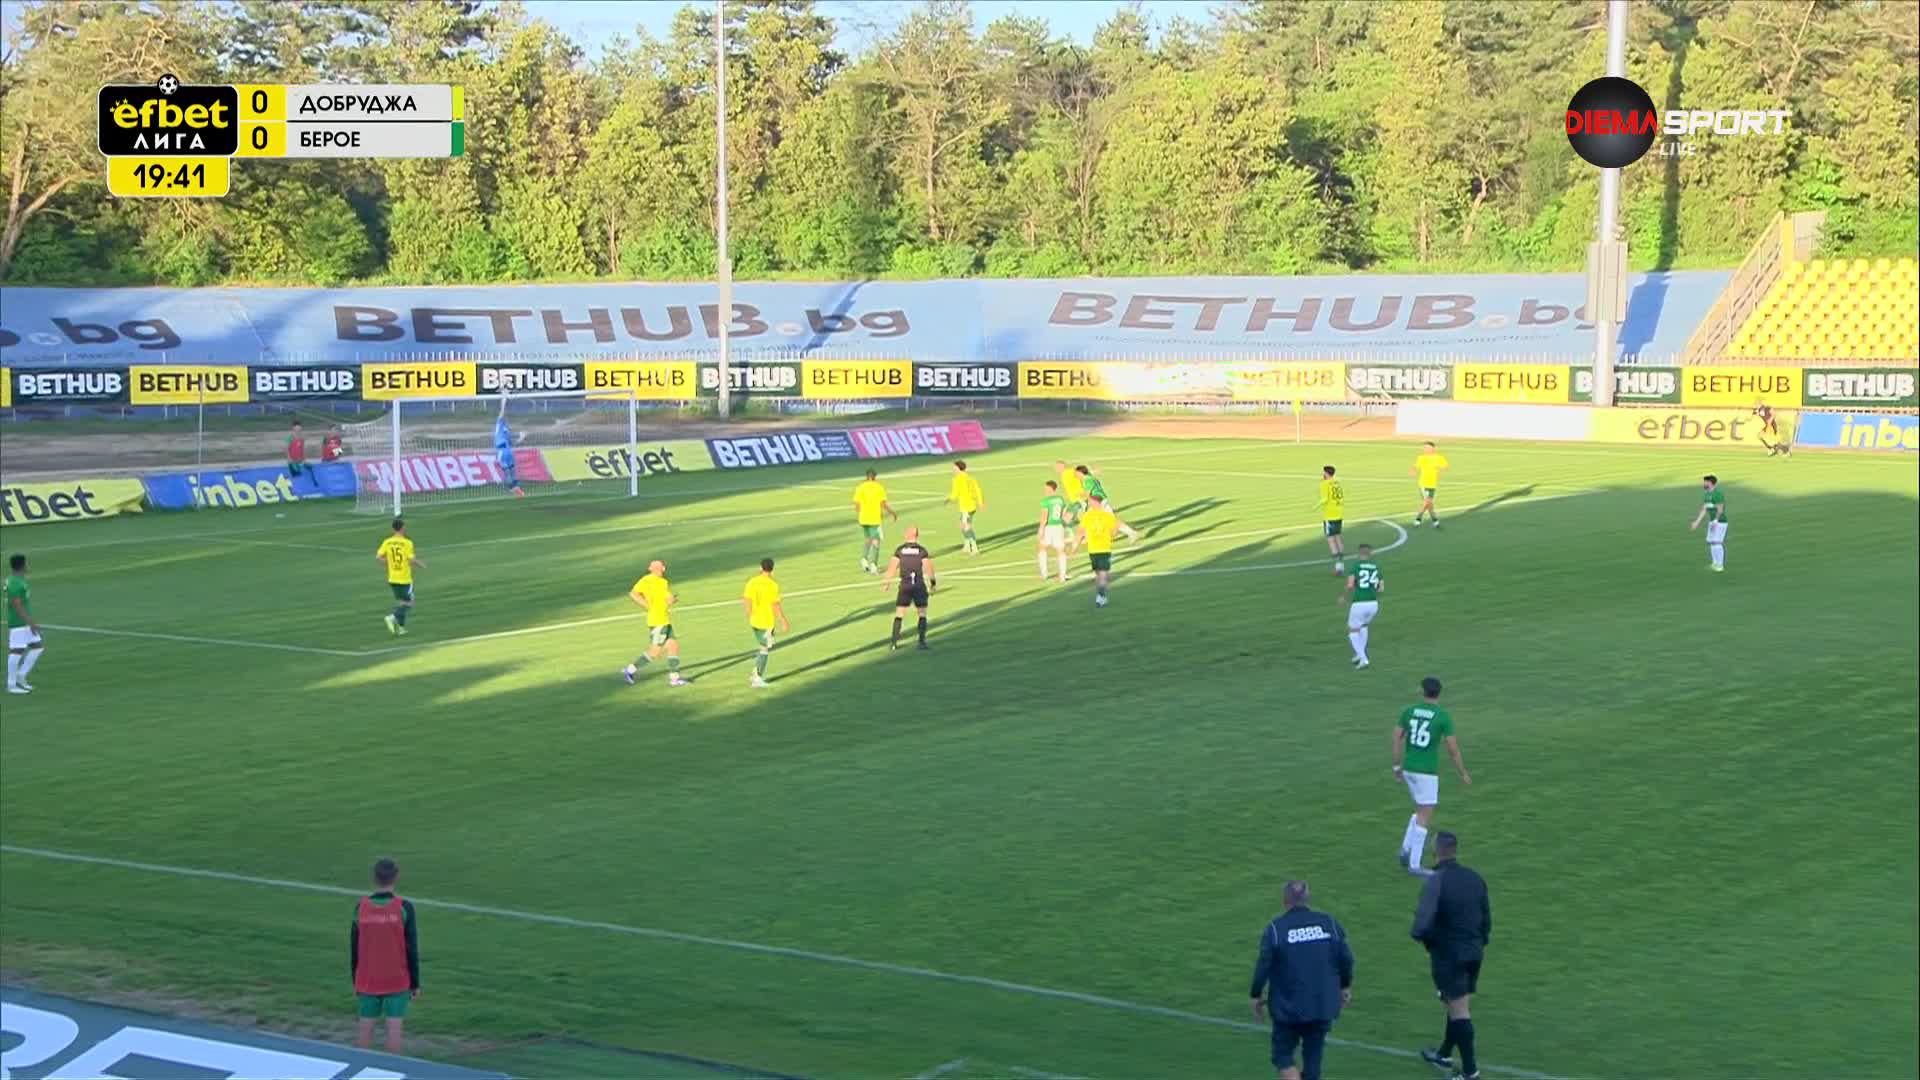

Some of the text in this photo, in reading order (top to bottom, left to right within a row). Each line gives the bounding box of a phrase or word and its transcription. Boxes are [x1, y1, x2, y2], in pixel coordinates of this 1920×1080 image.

[19, 371, 123, 395] BETHUB
[139, 373, 239, 395] BETHUB
[255, 370, 355, 393] BETHUB
[371, 370, 466, 389] BETHUB
[482, 367, 577, 390] BETHUB
[594, 369, 685, 388] BETHUB
[812, 368, 903, 386] BETHUB
[918, 366, 1011, 388] BETHUB
[1350, 367, 1448, 392] BETHUB
[1463, 372, 1558, 391] BETHUB
[1692, 374, 1790, 394] BETHUB
[1807, 372, 1915, 397] BETHUB
[1637, 414, 1746, 441] efbet
[713, 433, 822, 468] BETHUB
[862, 426, 951, 457] WINBET
[186, 473, 300, 507] inbet
[1359, 569, 1380, 589] 24
[1409, 718, 1431, 748] 16
